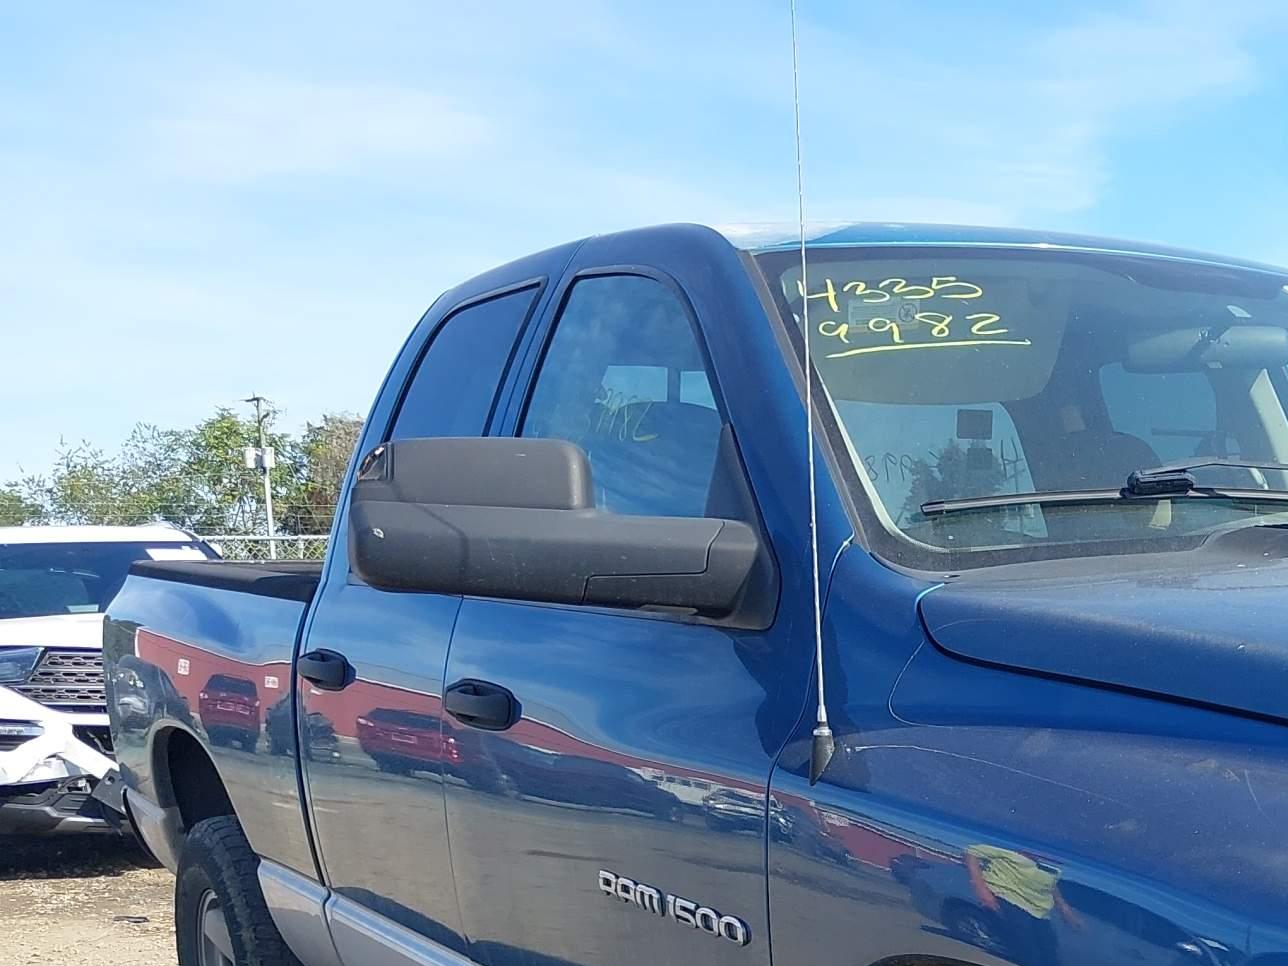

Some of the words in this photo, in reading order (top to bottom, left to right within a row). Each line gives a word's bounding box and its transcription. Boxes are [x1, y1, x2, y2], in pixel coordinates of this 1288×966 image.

[797, 276, 983, 313] 4335
[818, 312, 1008, 343] 9982
[598, 869, 666, 916] RAM
[666, 894, 752, 947] 1500
